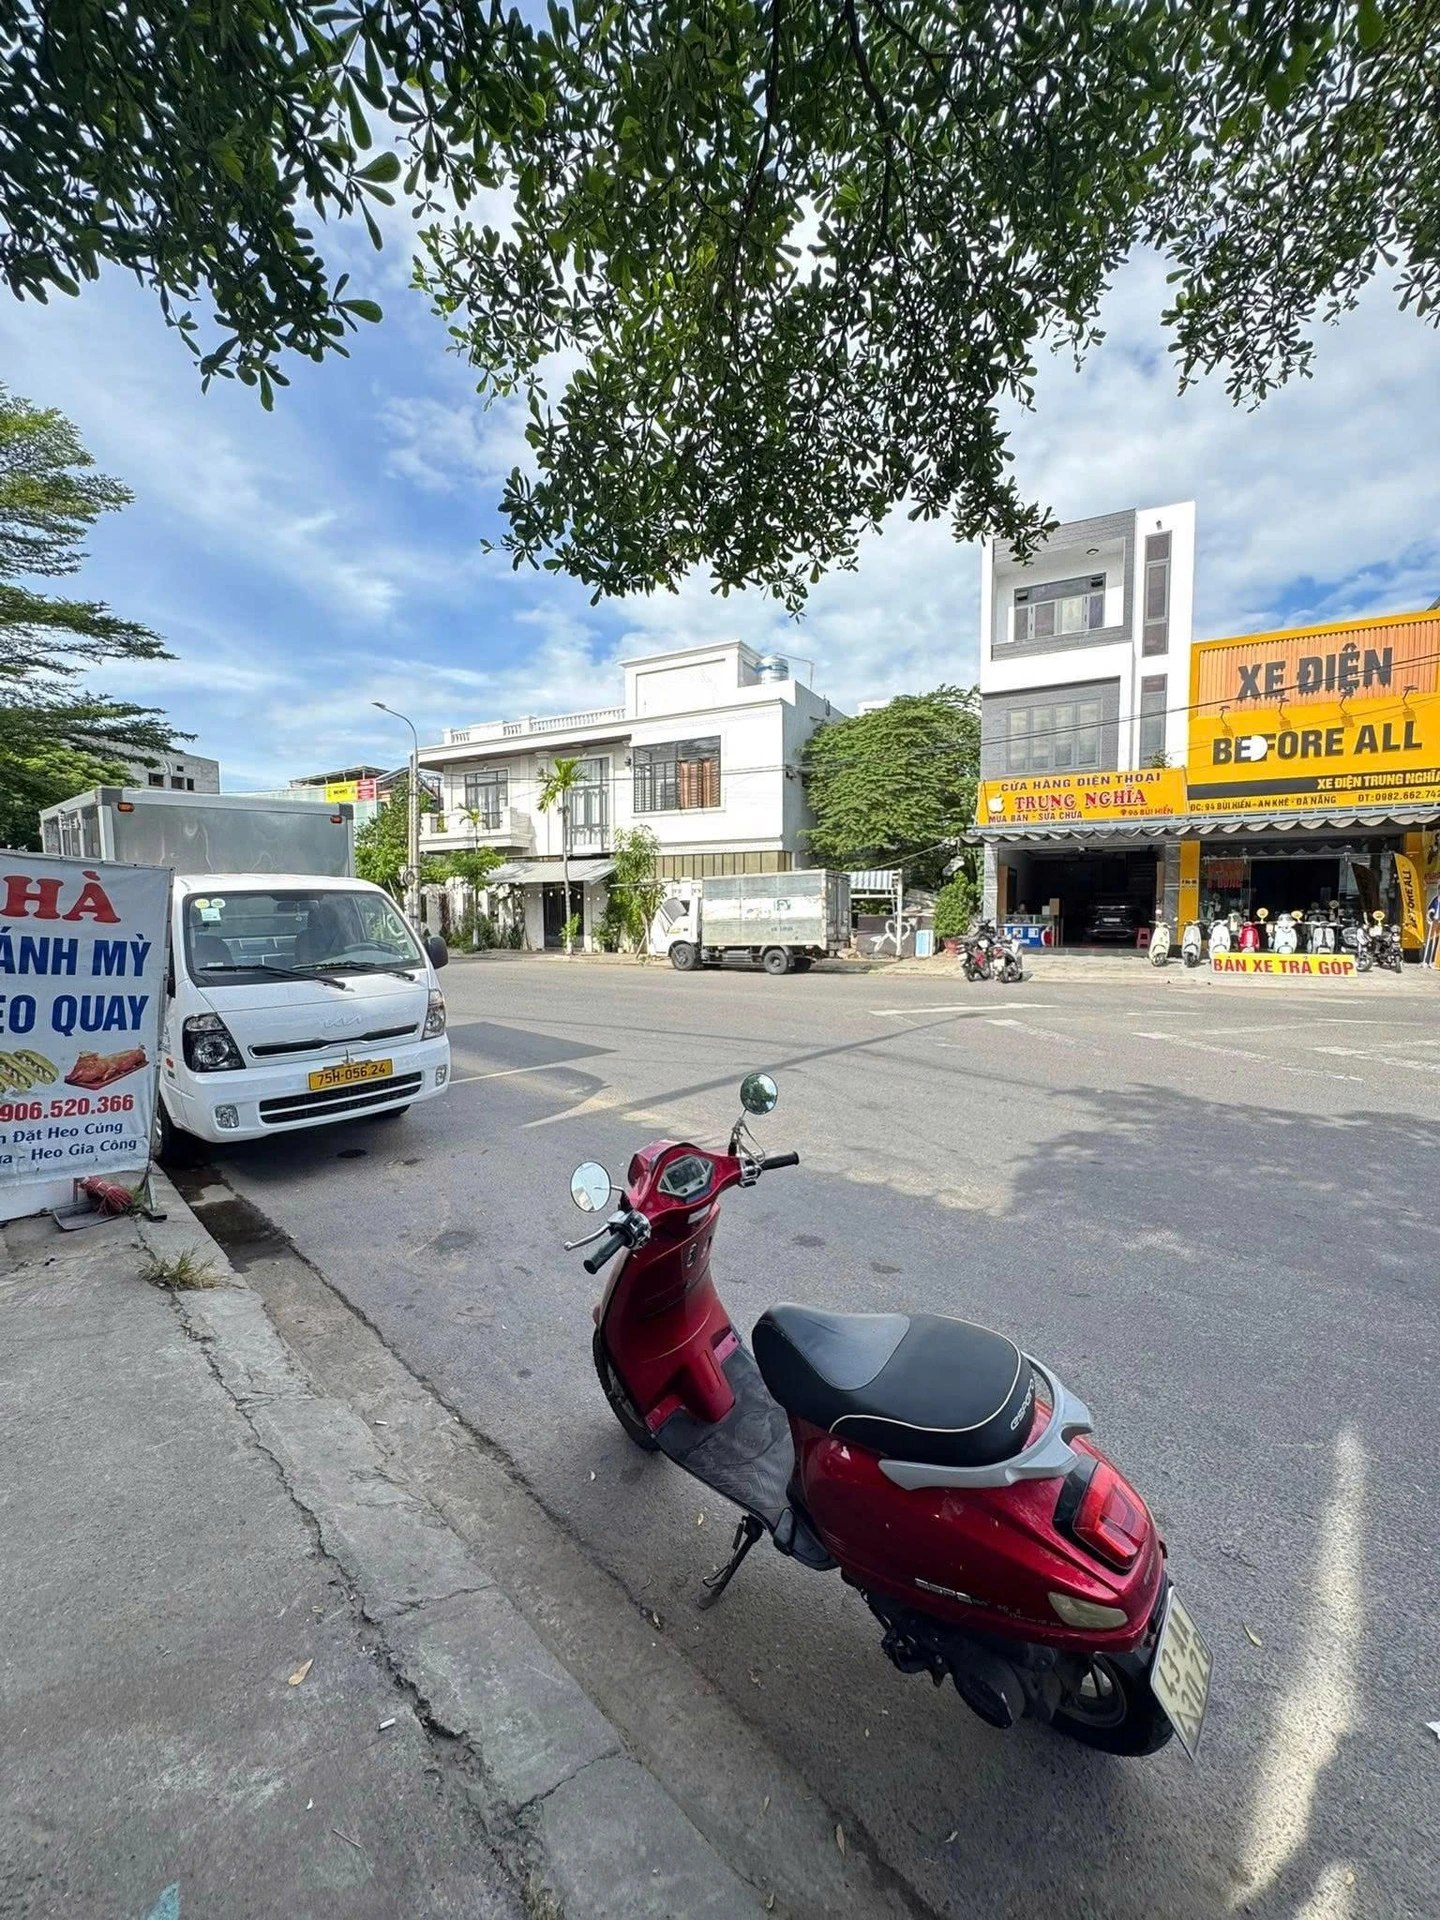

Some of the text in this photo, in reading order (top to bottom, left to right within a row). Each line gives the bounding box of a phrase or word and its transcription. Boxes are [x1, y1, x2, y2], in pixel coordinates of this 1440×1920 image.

[1238, 642, 1392, 701] XE ĐIỆN
[1212, 721, 1422, 766] BEFORE ALL
[1001, 772, 1161, 792] CỬA HÀNG ĐIỆN THOẠI
[1317, 778, 1333, 790] XE
[1334, 776, 1361, 790] ĐIỆN
[1363, 774, 1403, 787] TRUNG
[1015, 785, 1147, 811] TRUNG NGHĨA
[1258, 800, 1270, 808] AN
[989, 815, 1007, 823] MUA
[0, 871, 121, 923] HÀ
[92, 933, 152, 976] MỲ
[1213, 955, 1354, 975] BÁN XE TRẢ GÓP
[52, 994, 149, 1037] QUAY
[13, 1130, 42, 1145] Đặt
[48, 1126, 79, 1139] Heo
[85, 1122, 123, 1136] Cúng
[31, 1148, 62, 1161] Heo
[69, 1143, 94, 1156] Gia
[100, 1138, 137, 1152] Công
